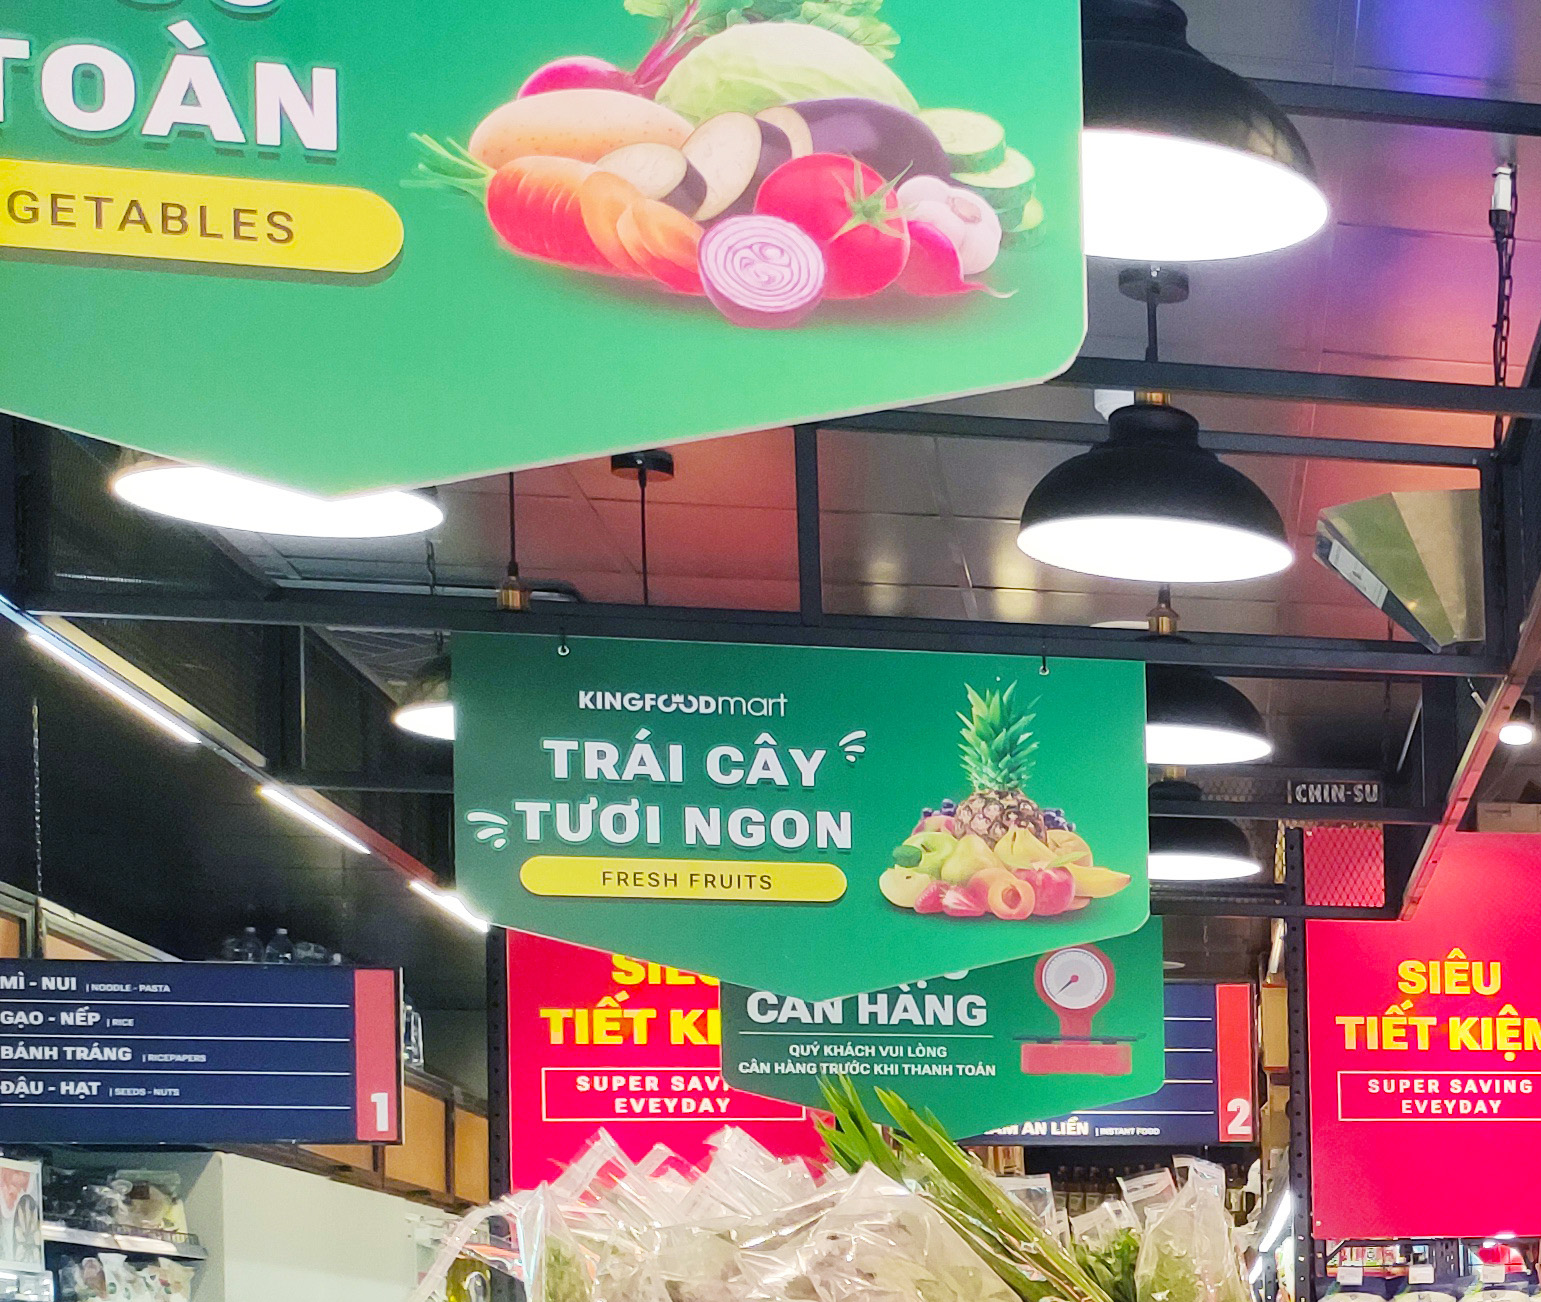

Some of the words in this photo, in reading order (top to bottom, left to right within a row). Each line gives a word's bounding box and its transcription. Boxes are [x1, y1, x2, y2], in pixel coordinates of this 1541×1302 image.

[6, 189, 295, 244] GETABLES
[543, 728, 684, 783] TRÁI
[707, 733, 827, 787] CÂY
[1296, 784, 1379, 803] CHIN-SU
[514, 796, 660, 844] TƯƠI
[685, 806, 851, 849] NGON
[602, 871, 678, 889] FRESH
[690, 873, 772, 890] FRUITS
[1398, 948, 1501, 996] SIÊU
[41, 976, 77, 991] NUI
[91, 983, 132, 992] NOODLE
[139, 984, 171, 993] PASTA
[858, 984, 988, 1028] HÀNG
[0, 1011, 44, 1029] GẠO
[60, 1006, 101, 1026] NẾP
[112, 1018, 135, 1027] RICE
[540, 990, 656, 1045] TIẾT
[1335, 1002, 1437, 1051] TIẾT
[0, 1046, 58, 1061] BÁNH
[63, 1046, 133, 1061] TRÁNG
[148, 1054, 207, 1063] RICEPAPERS
[788, 1042, 820, 1059] QUÝ
[823, 1042, 876, 1058] KHÁCH
[879, 1045, 904, 1058] VUI
[908, 1043, 948, 1058] LÒNG
[738, 1060, 775, 1075] CÂN
[777, 1060, 818, 1076] HÀNG
[820, 1059, 871, 1076] TRƯỚC
[873, 1063, 899, 1076] KHI
[902, 1063, 952, 1076] THANH
[954, 1060, 996, 1077] TOÁN
[60, 1080, 101, 1099] HẠT
[115, 1087, 146, 1097] SEEDS
[153, 1088, 180, 1097] NUTS
[576, 1075, 658, 1092] SUPER
[1368, 1079, 1440, 1094] SUPER
[1450, 1079, 1533, 1094] SAVING
[370, 1092, 390, 1132] 1
[614, 1098, 731, 1114] EVEYDAY
[1401, 1099, 1502, 1114] EVEYDAY
[1050, 1116, 1089, 1136] LIỀN
[1227, 1099, 1251, 1135] 2
